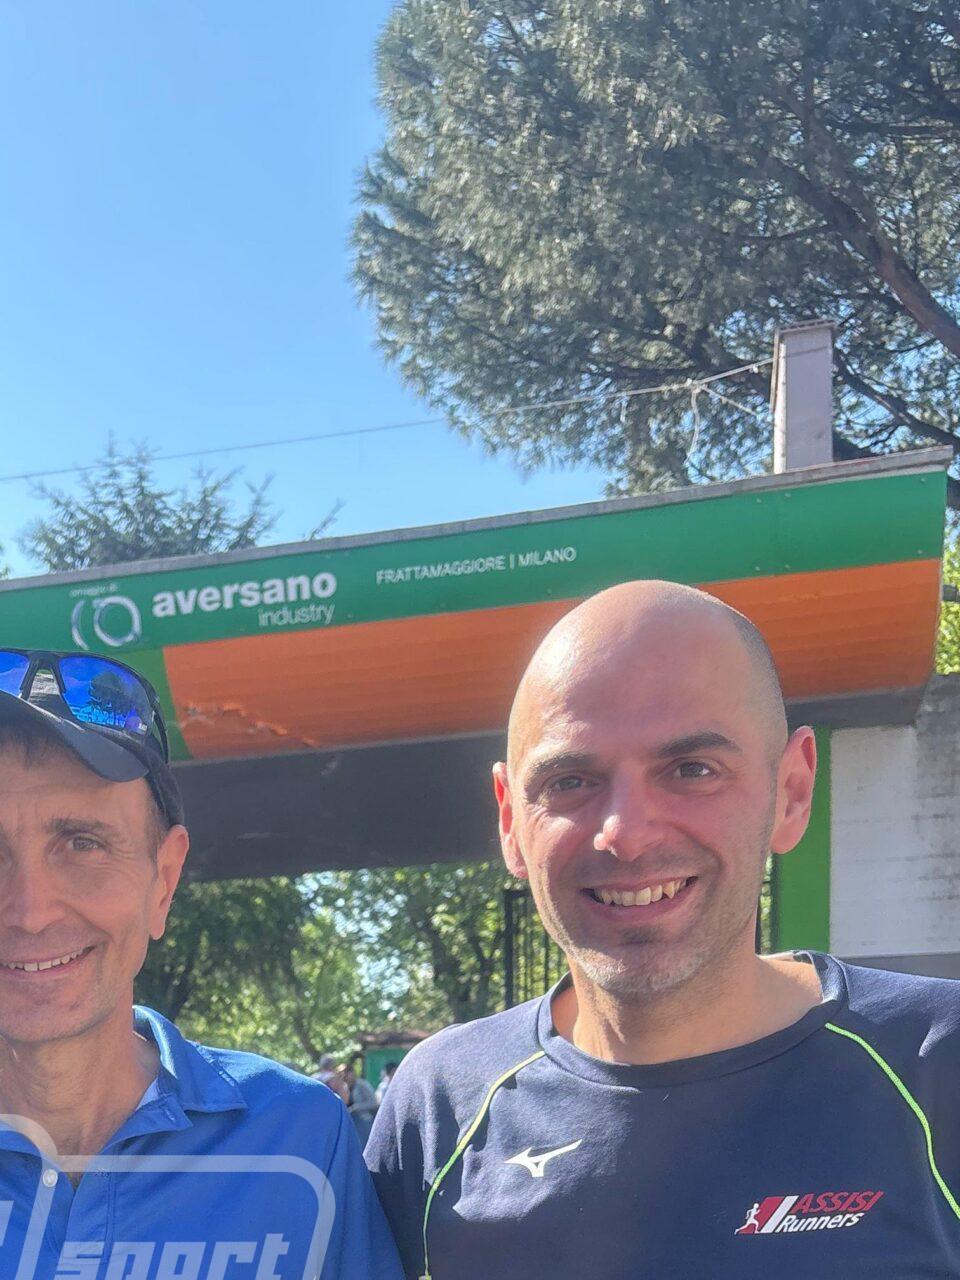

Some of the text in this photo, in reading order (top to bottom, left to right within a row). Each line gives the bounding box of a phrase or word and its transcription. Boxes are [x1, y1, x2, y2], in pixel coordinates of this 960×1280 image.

[376, 555, 507, 585] FRATTAMAGGIORE
[518, 546, 577, 568] MILANO
[152, 571, 338, 618] aversano
[258, 603, 336, 627] industry
[790, 1191, 885, 1214] ASSISI
[775, 1212, 865, 1233] Runners
